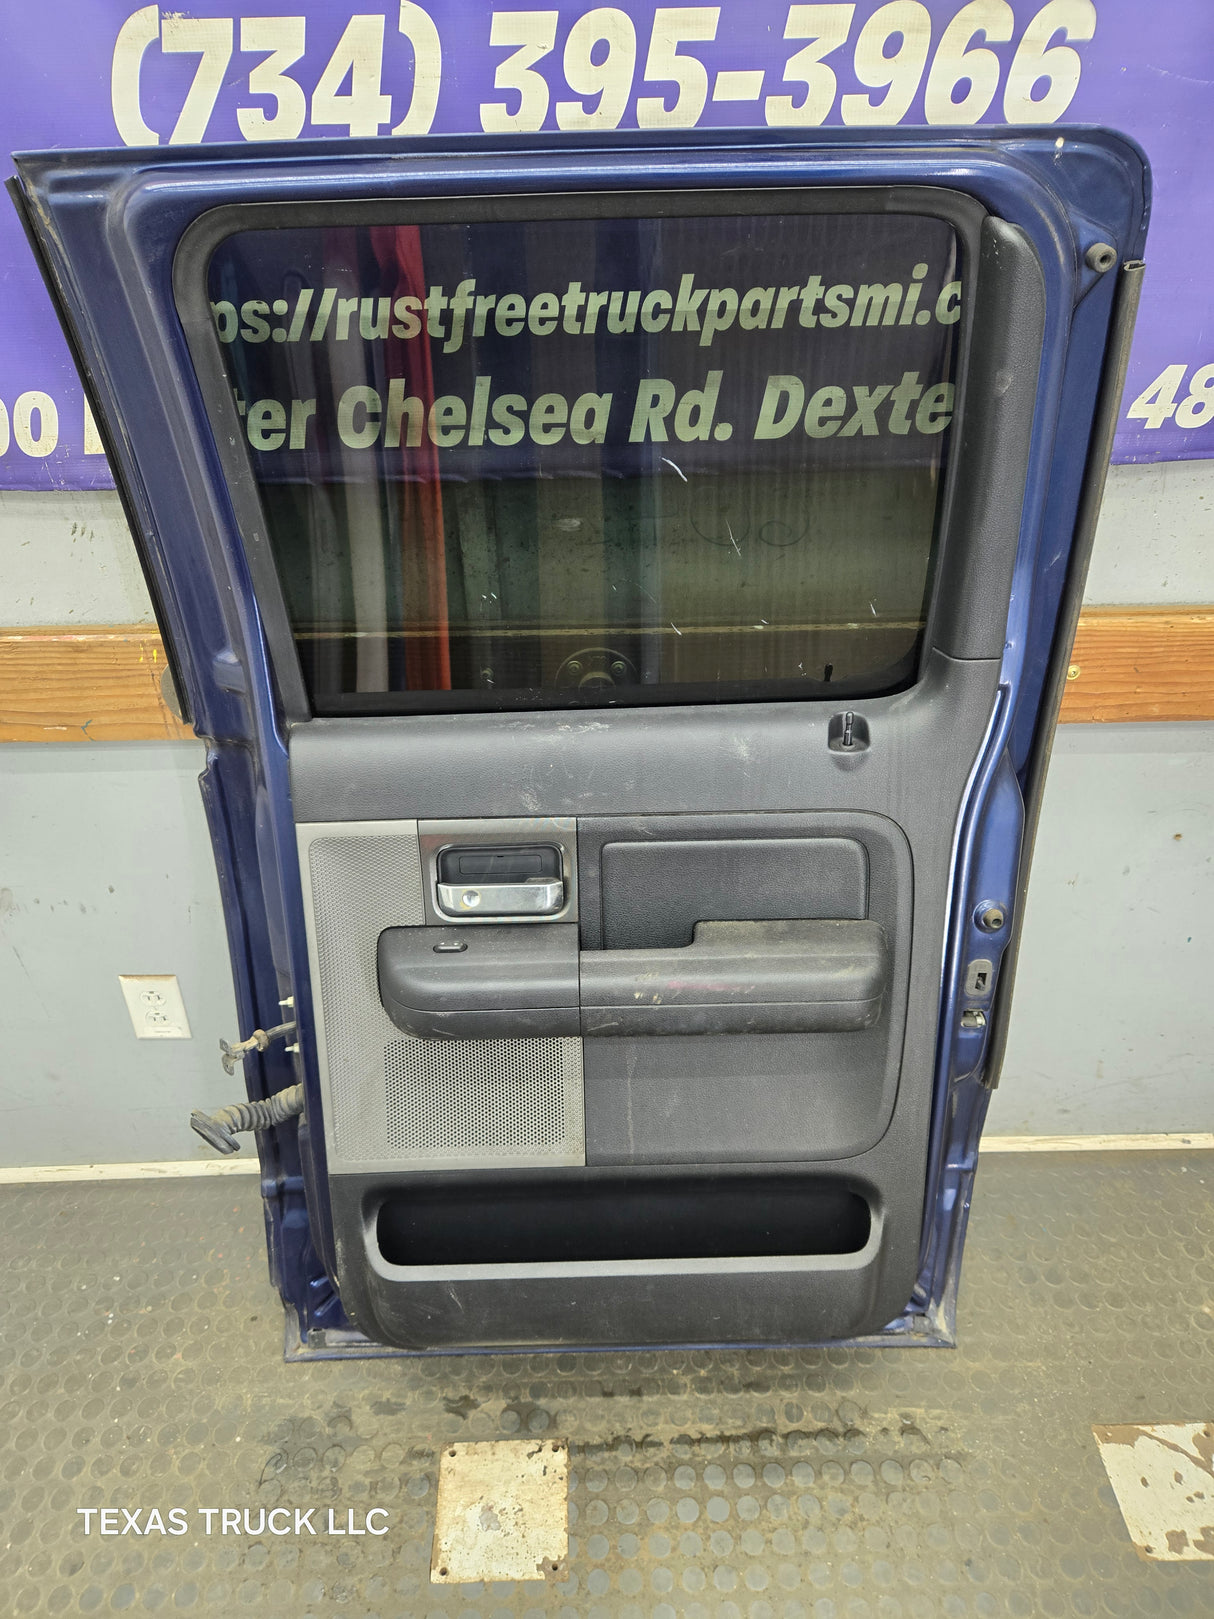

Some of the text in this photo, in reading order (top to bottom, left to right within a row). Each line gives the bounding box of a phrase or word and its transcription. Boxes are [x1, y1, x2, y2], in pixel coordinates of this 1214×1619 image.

[111, 0, 1097, 146] (734) 395-3966
[337, 376, 614, 450] Chelsea
[628, 370, 733, 443] Rd.
[753, 370, 956, 440] Dexte
